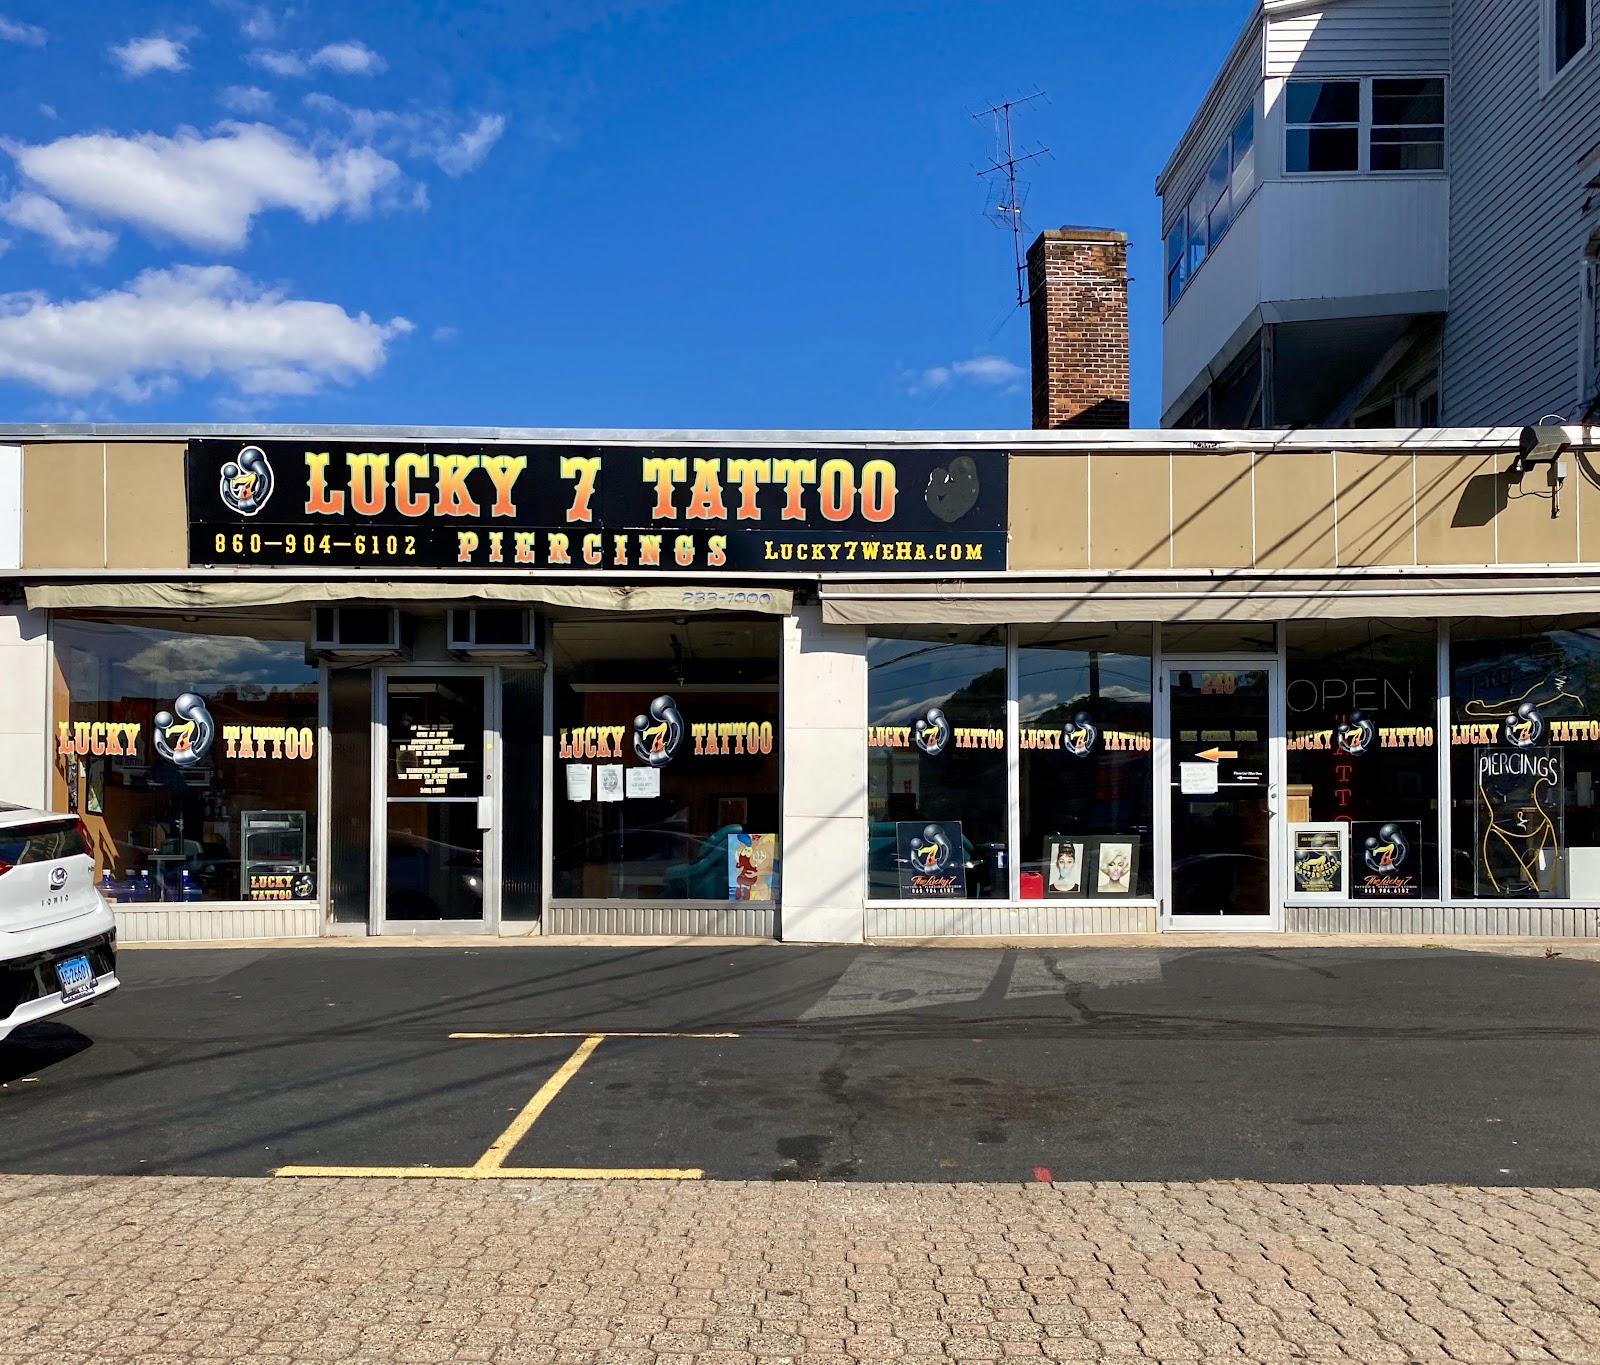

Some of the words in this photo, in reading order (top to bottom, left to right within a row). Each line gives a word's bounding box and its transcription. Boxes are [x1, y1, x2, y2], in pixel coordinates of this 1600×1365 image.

[304, 451, 528, 518] LUCKY
[560, 456, 602, 523] 7
[642, 456, 900, 523] TATTOO
[215, 533, 417, 556] 860-904-6102
[457, 531, 728, 567] PIERCINGS
[1287, 676, 1412, 712] OPEN
[58, 721, 141, 756] LUCKY
[166, 720, 196, 751] 7
[222, 725, 315, 760] TATTOO
[559, 725, 626, 759] LUCKY
[643, 721, 668, 753] 7
[691, 720, 773, 756] TATTOO
[868, 726, 912, 747] LUCKY
[920, 725, 939, 746] 7
[954, 727, 1004, 750] TATTOO
[1020, 729, 1062, 750] LUCKY
[1103, 730, 1151, 752] TATTOO
[1287, 729, 1333, 750] LUCKY
[1378, 726, 1434, 748] TATTOO
[1451, 724, 1499, 745] LUCKY
[1513, 720, 1532, 741] 7
[1550, 720, 1600, 742] TATTO
[1480, 752, 1558, 786] PIERCINGS
[250, 875, 294, 889] LUCKY
[250, 889, 292, 901] TATTOO
